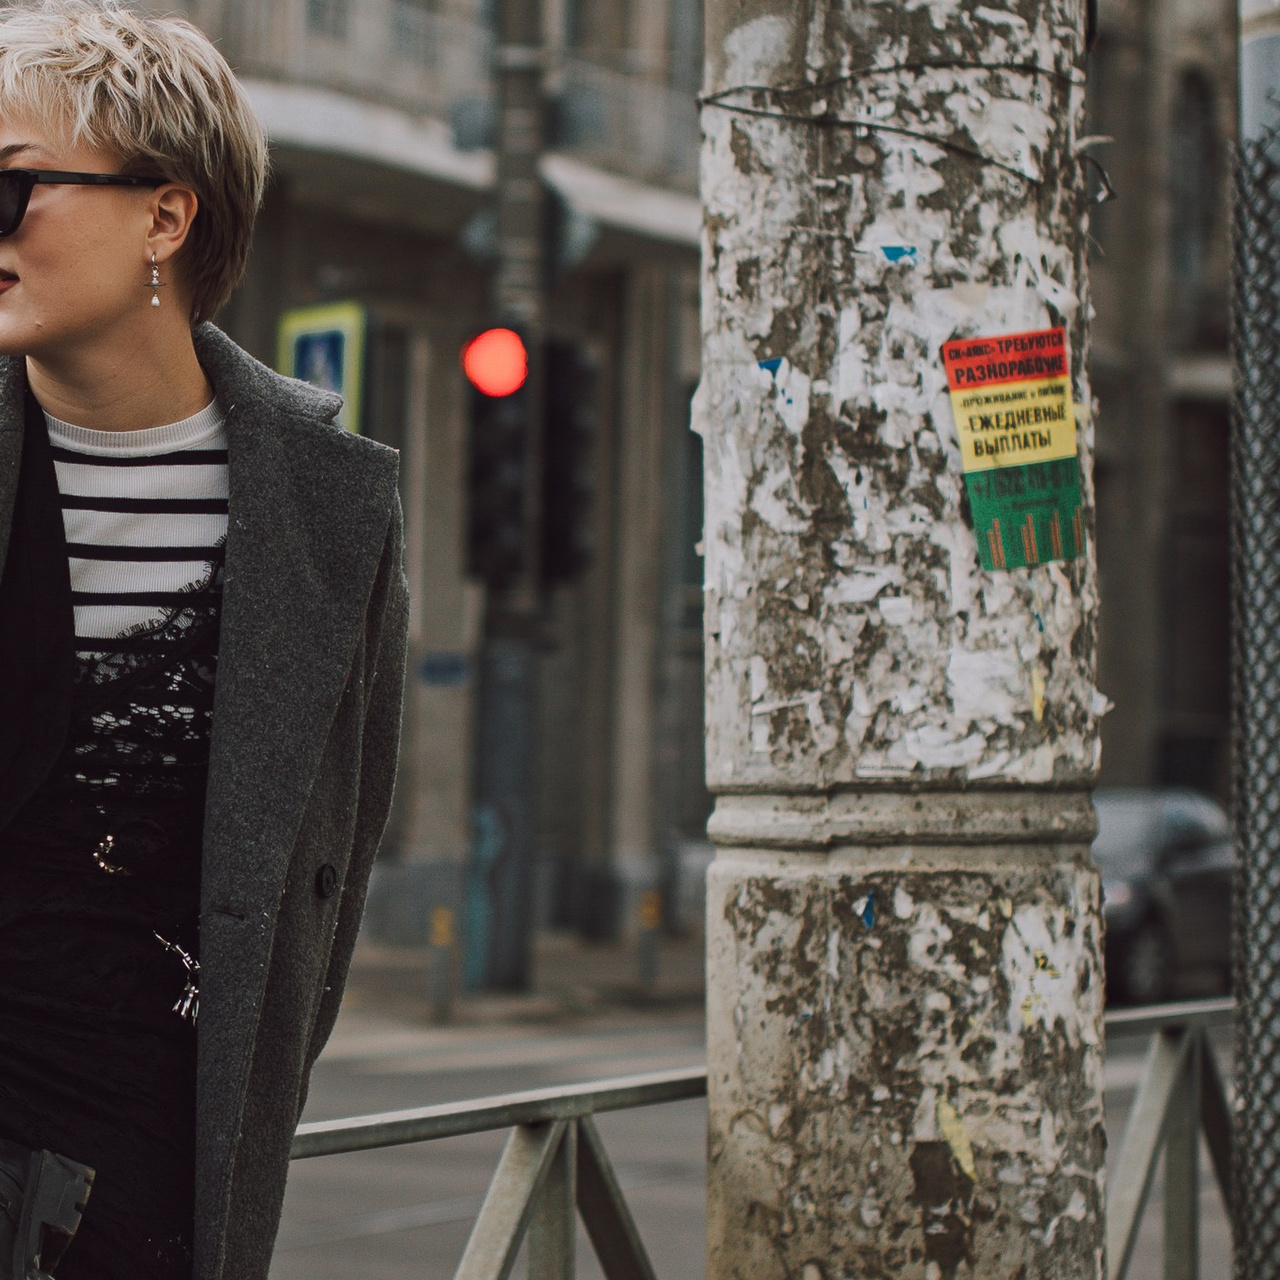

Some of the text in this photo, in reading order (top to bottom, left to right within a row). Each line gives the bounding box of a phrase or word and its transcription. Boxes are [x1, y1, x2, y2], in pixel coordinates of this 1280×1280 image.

[997, 332, 1063, 355] ТРЕБУЮТСЯ
[954, 354, 1063, 385] РАЗНОРАБОЧИЕ
[973, 429, 1051, 457] ВЫПЛАТЫ
